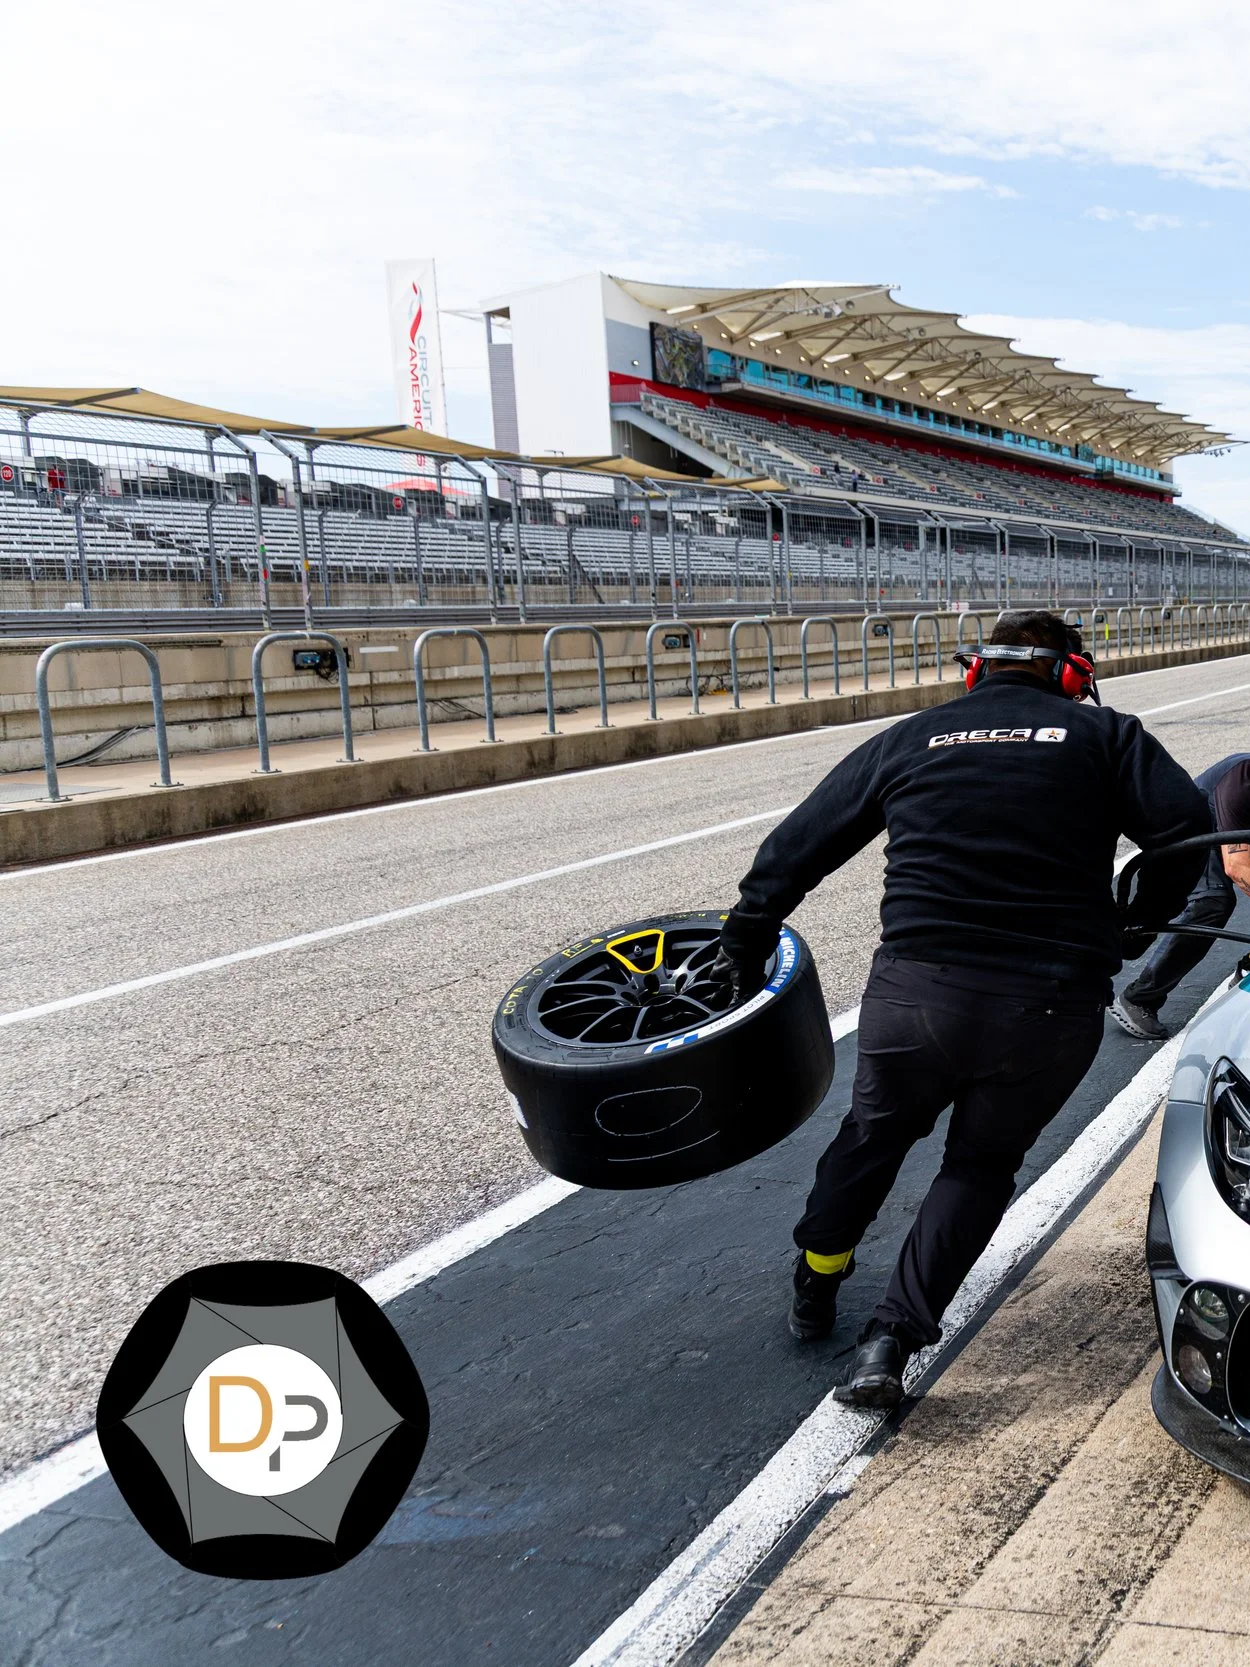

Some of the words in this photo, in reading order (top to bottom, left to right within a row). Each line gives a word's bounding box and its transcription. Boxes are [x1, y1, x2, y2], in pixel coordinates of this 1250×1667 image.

[417, 336, 433, 425] CIRCUIT
[409, 346, 426, 467] AMERICS
[928, 728, 1033, 748] ORECA
[769, 936, 796, 988] MICHELIN
[502, 984, 528, 1015] COTA
[742, 995, 766, 1014] PILOT
[709, 1011, 742, 1031] SPORT
